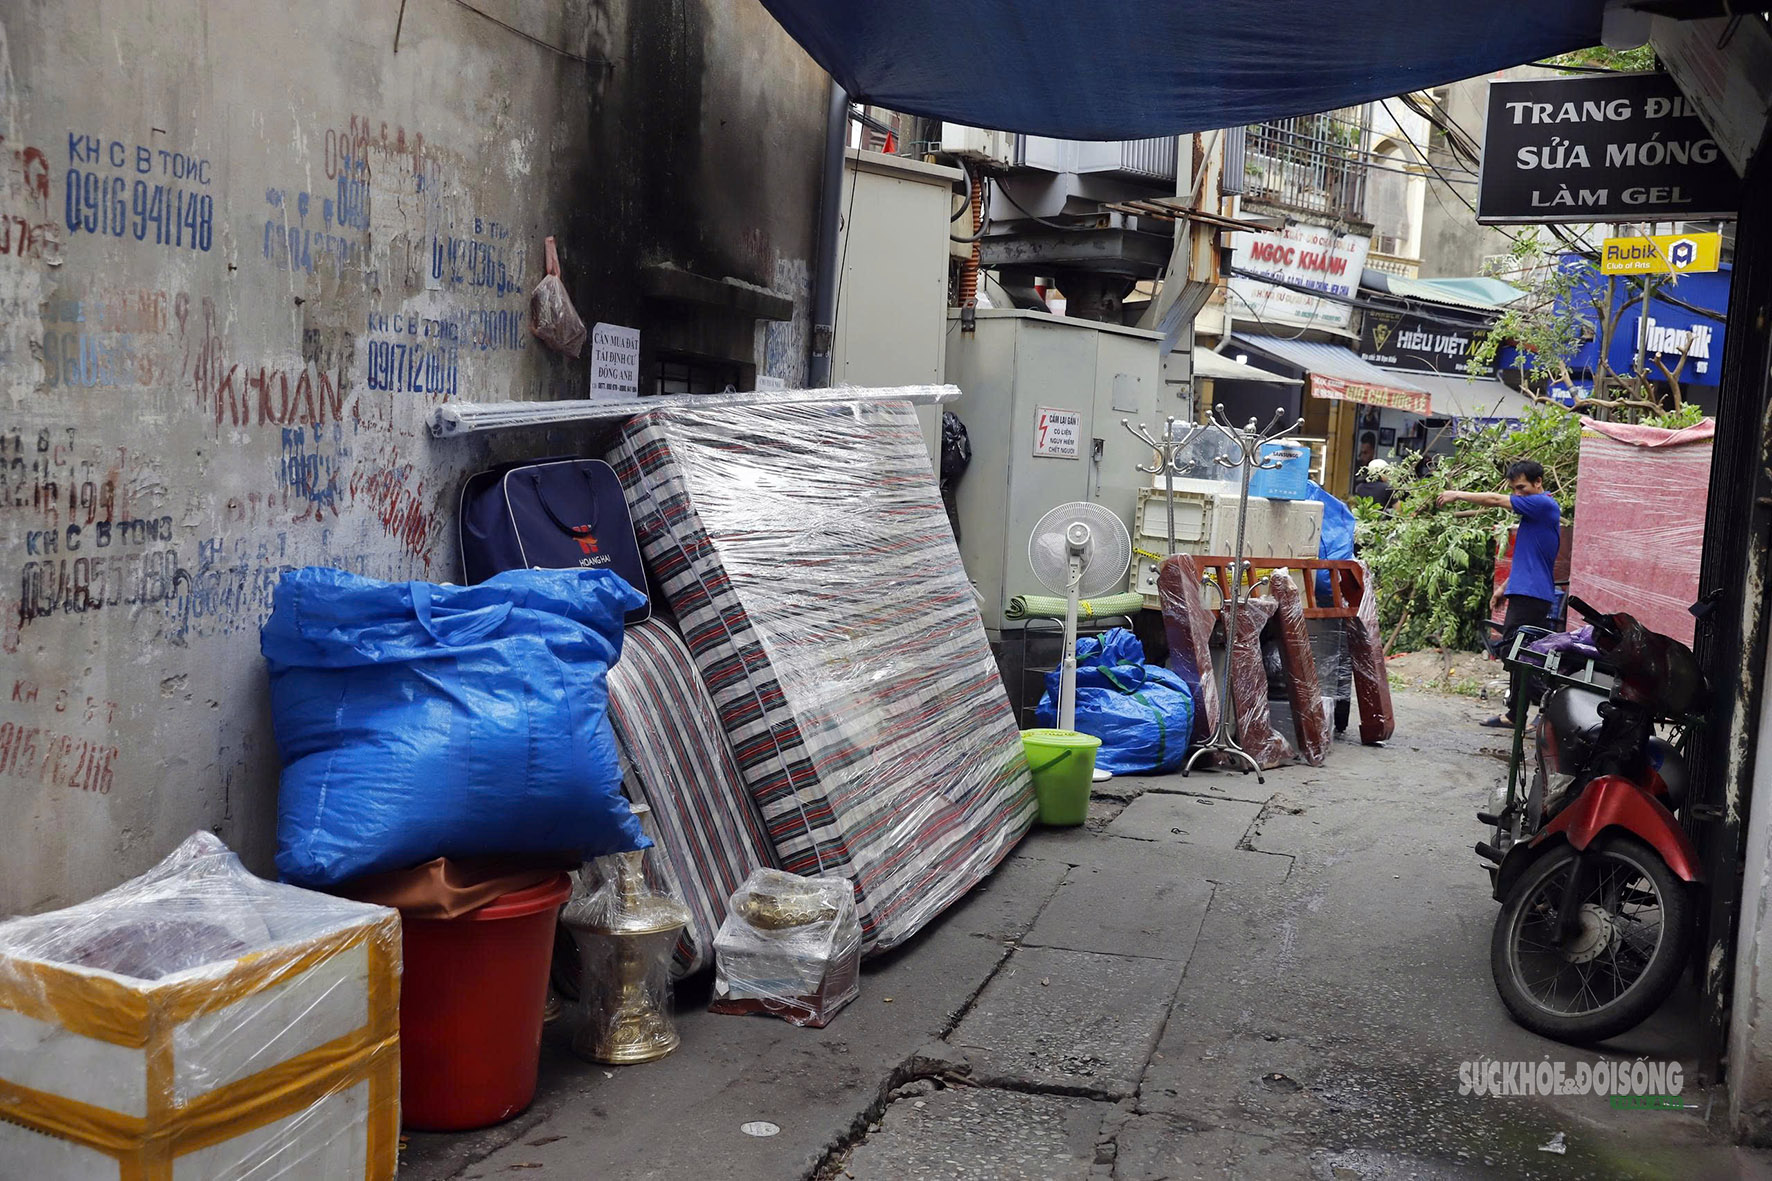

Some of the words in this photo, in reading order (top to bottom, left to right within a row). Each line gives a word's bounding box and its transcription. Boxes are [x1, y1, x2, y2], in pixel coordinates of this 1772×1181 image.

[1505, 99, 1632, 125] TRANG
[1516, 136, 1591, 170] SỬA
[1605, 132, 1719, 169] MÓNG
[1531, 184, 1609, 207] LÀM
[1621, 187, 1693, 205] GEL
[1297, 248, 1348, 276] KHÁNH
[1607, 244, 1657, 260] Rubik
[1606, 262, 1624, 270] Club
[610, 335, 625, 348] MUA
[1434, 331, 1468, 358] VIỆT
[620, 370, 633, 381] ANH
